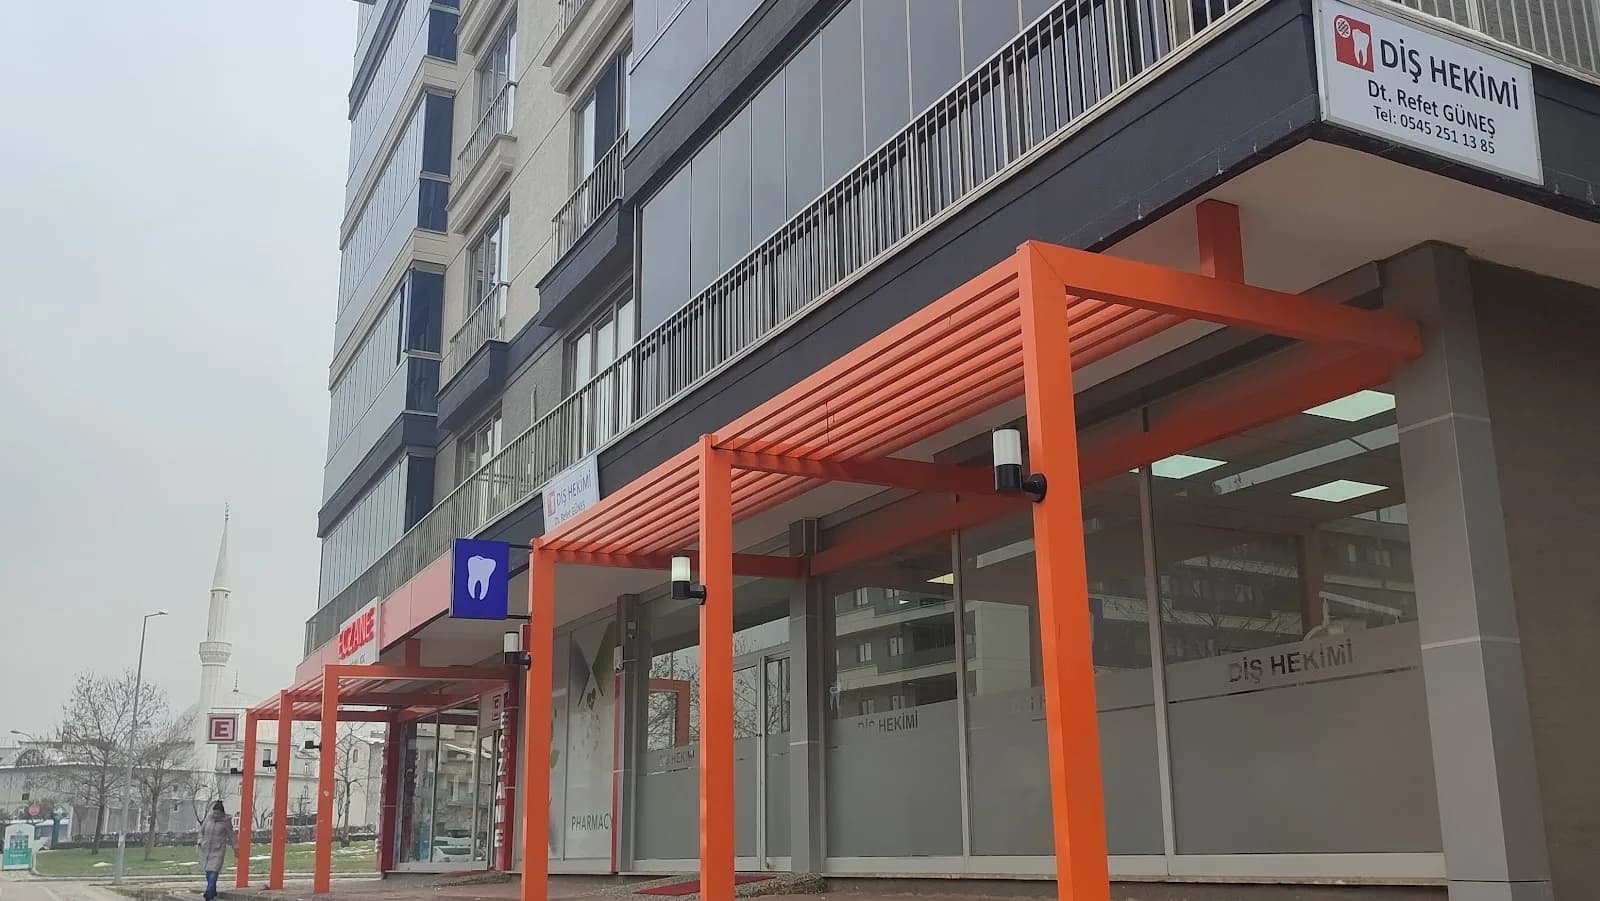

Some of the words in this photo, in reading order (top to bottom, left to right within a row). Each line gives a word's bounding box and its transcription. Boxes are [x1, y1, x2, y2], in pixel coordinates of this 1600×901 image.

[1380, 38, 1422, 84] DİŞ
[1429, 55, 1519, 110] HEKİMİ
[1367, 79, 1392, 103] Dt.
[1397, 88, 1438, 118] Refet
[1443, 103, 1496, 139] GÜNEŞ
[1373, 105, 1397, 125] Tel:
[1400, 113, 1432, 135] 0545
[1435, 124, 1458, 144] 251
[1463, 132, 1477, 149] 13
[1480, 137, 1495, 154] 85
[338, 607, 375, 660] ECZANE
[1229, 656, 1262, 684] DİŞ
[1270, 638, 1353, 676] HEKİMİ
[215, 721, 230, 737] E
[878, 710, 918, 733] HEKİMİ
[494, 711, 509, 848] ECZANE
[571, 812, 611, 831] PHARMAC
